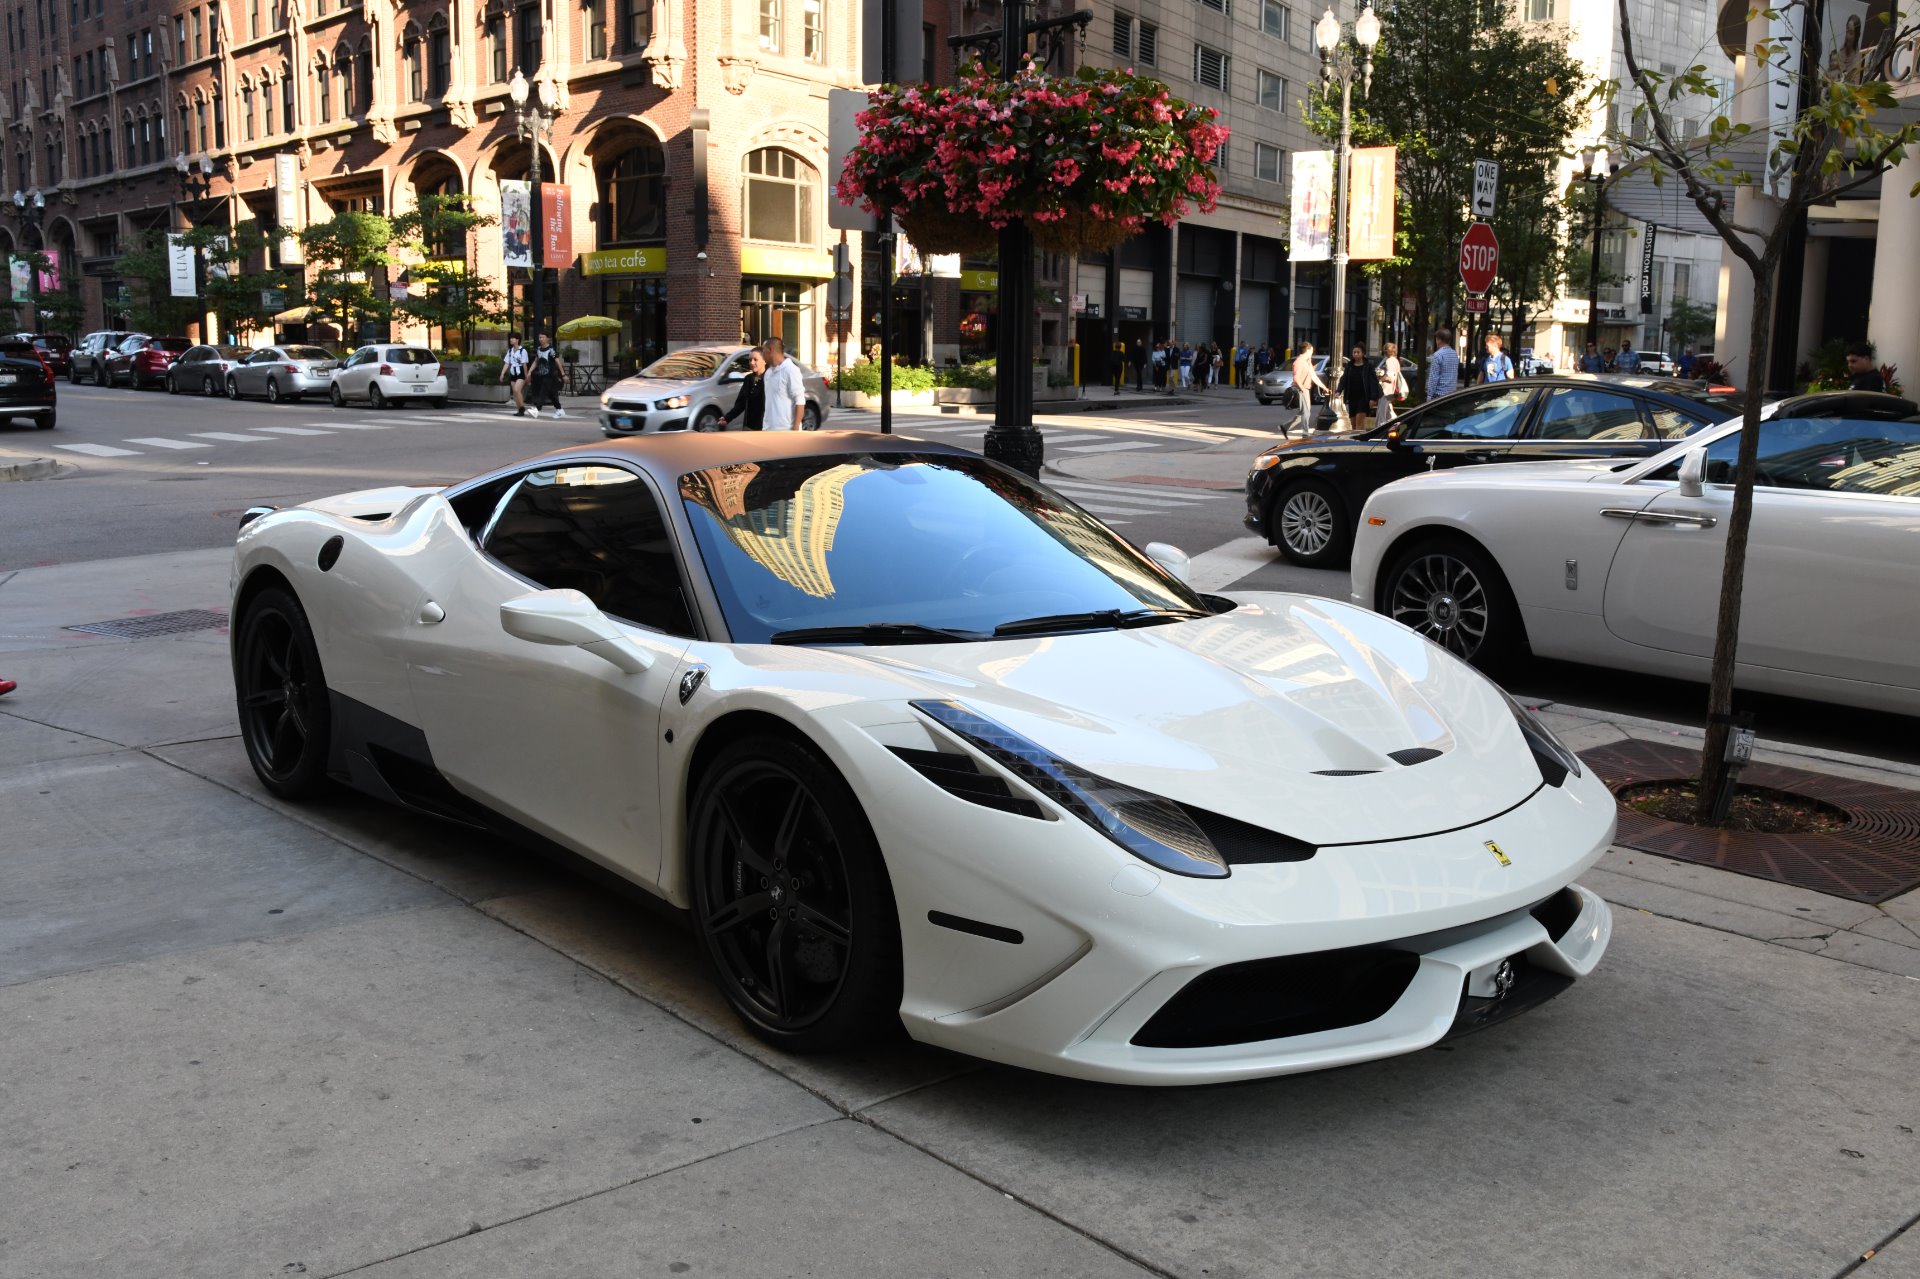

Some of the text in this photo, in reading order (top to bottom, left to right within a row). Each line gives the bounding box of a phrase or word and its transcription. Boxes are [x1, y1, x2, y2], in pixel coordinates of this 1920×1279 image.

[1478, 164, 1495, 180] ONE
[1476, 180, 1495, 195] WAY
[556, 188, 564, 233] Following
[177, 247, 189, 280] LUM
[604, 256, 617, 268] tea
[620, 249, 647, 268] café
[1462, 244, 1496, 272] STOP
[1641, 223, 1654, 298] ORDSTROM rack
[1467, 301, 1486, 310] ALL WAY
[1610, 306, 1626, 318] rack
